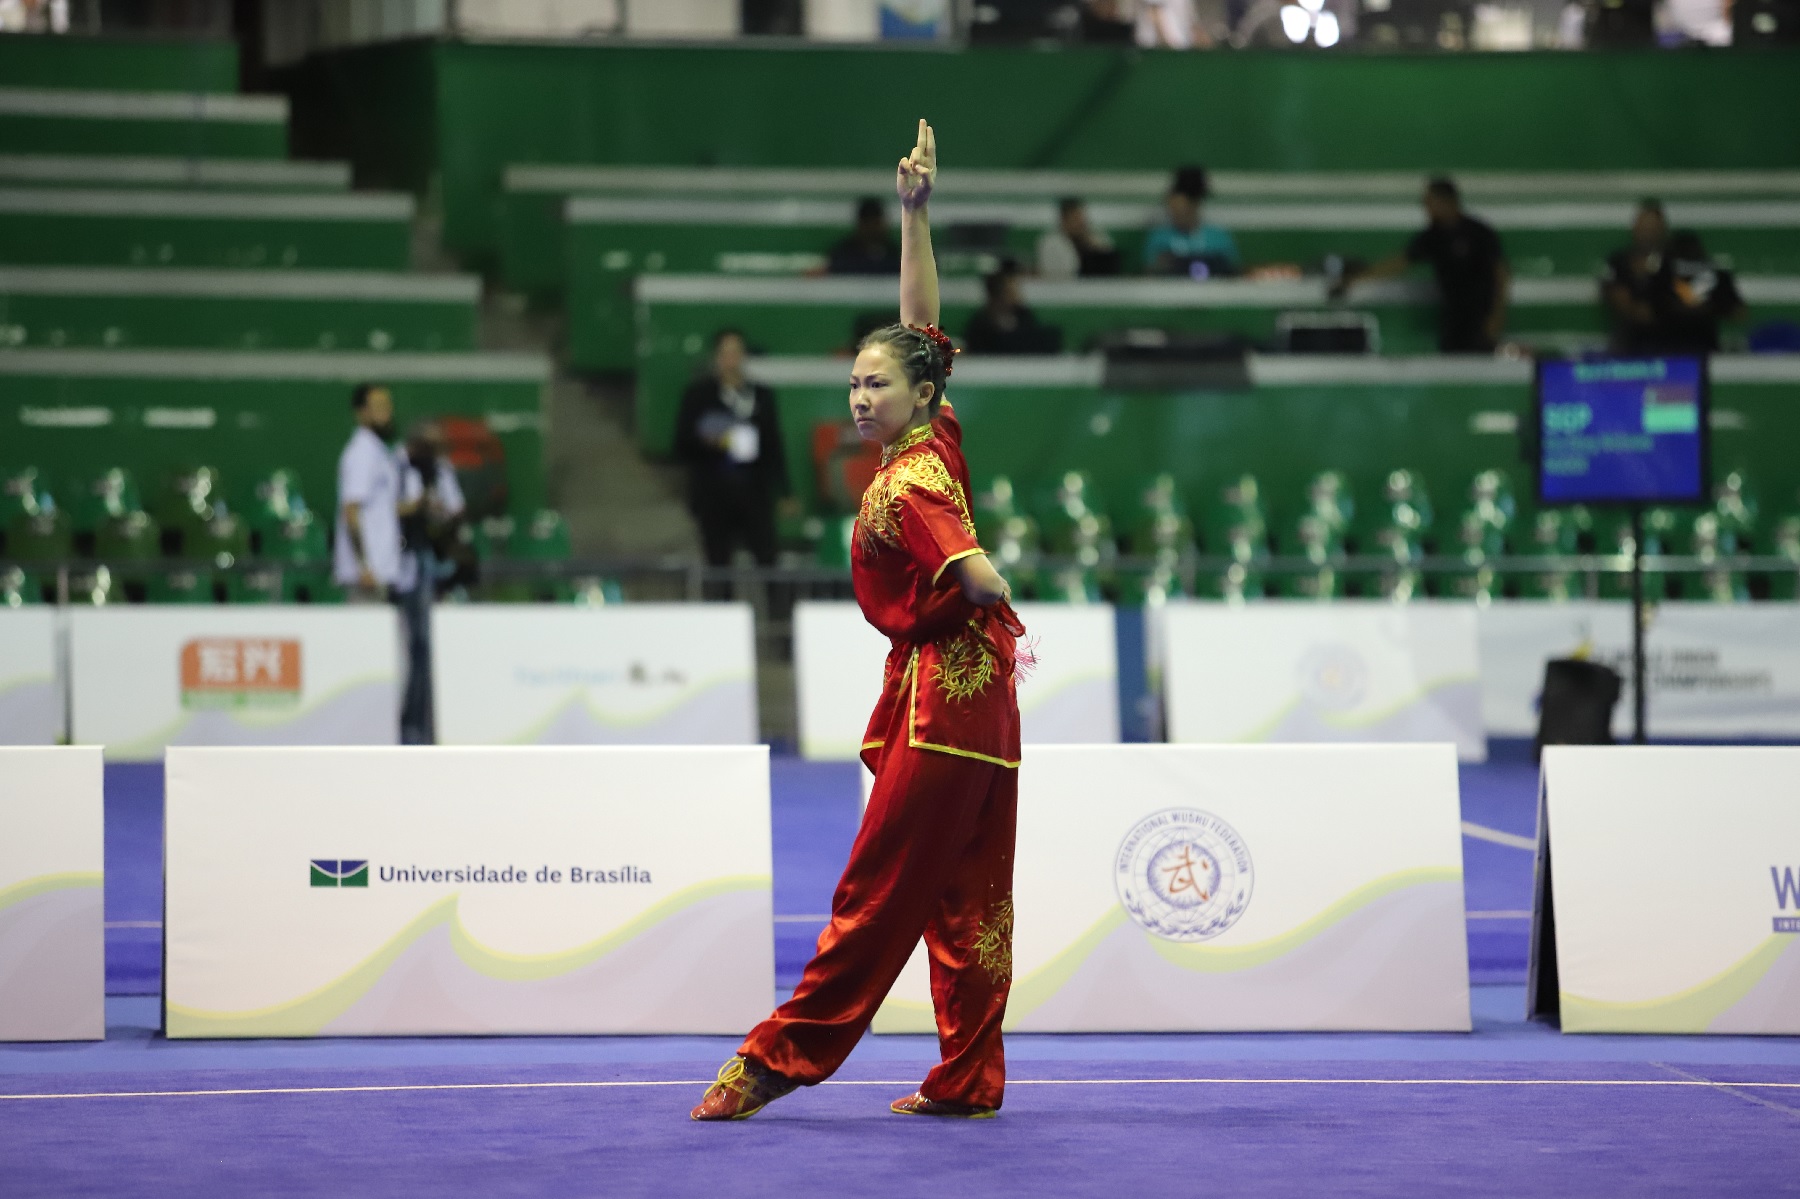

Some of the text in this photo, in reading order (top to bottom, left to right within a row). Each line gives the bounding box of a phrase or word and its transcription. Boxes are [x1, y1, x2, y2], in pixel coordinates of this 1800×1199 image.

[1118, 811, 1248, 874] INTERNATIONAL WUSHU FEDERATION
[379, 863, 652, 884] Universidade de Brasília
[1161, 845, 1209, 902] 武
